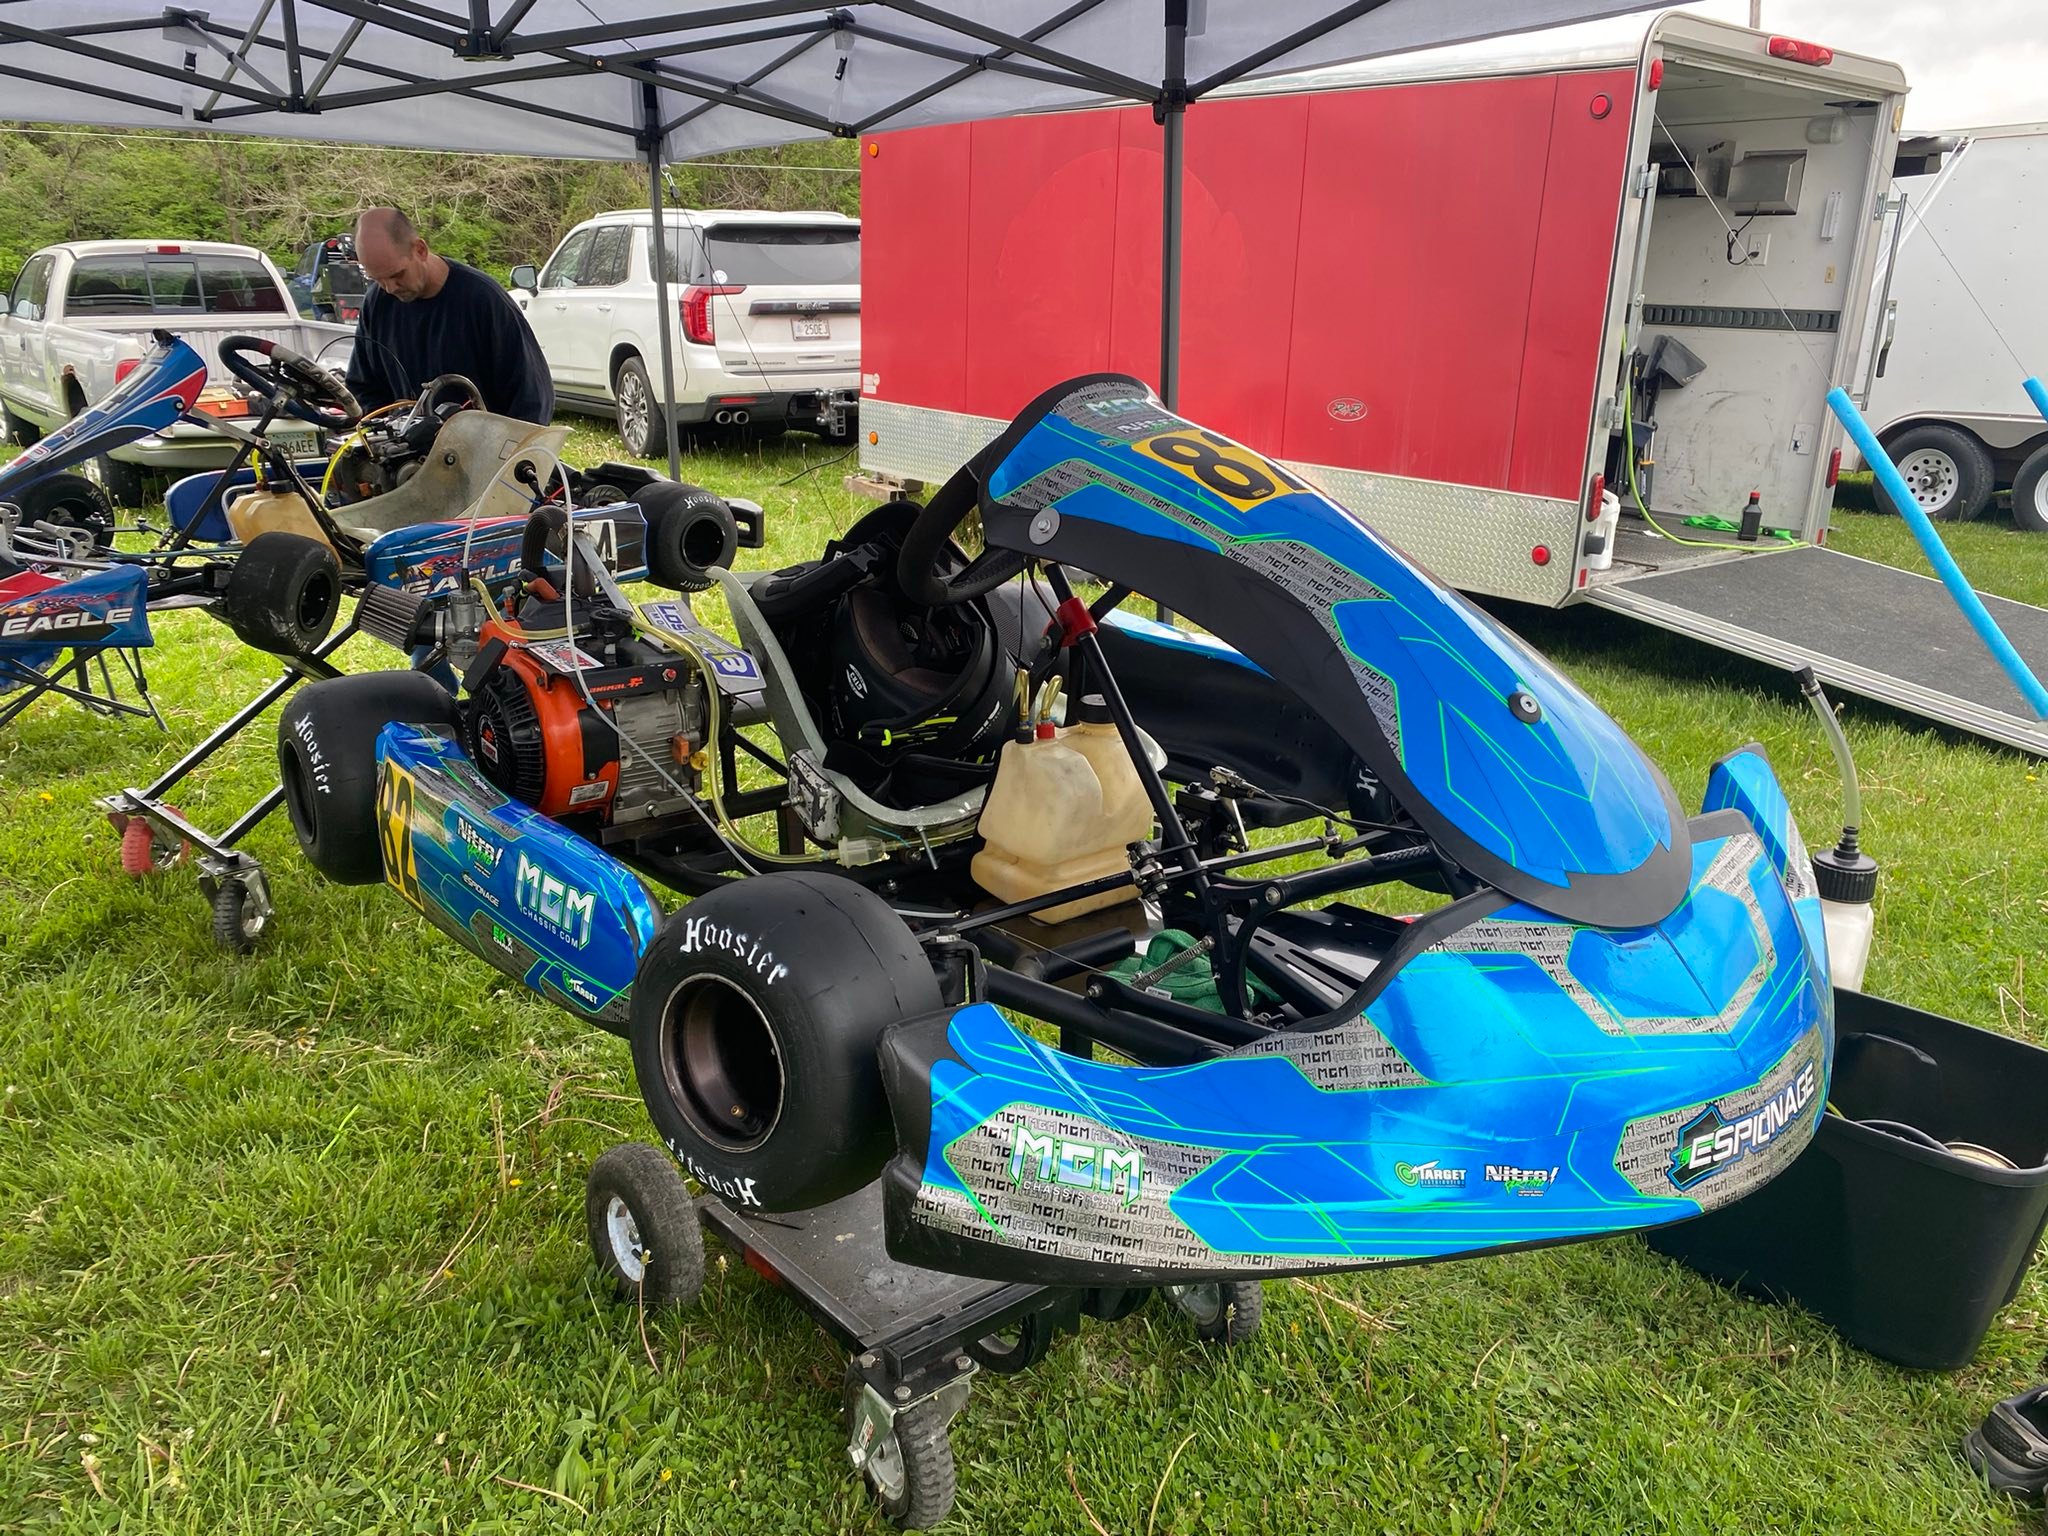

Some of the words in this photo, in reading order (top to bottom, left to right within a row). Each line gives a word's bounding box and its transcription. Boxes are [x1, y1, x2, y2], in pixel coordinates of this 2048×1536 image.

[2, 608, 133, 636] EAGLE
[294, 712, 331, 794] Hoosier
[379, 762, 423, 906] 82
[462, 873, 500, 907] ESPIONAGE
[516, 850, 597, 952] MGM
[522, 906, 579, 949] CHASSIS.COM
[680, 916, 791, 985] Hoosier
[572, 979, 599, 1005] TARGET
[1688, 1062, 1815, 1169] ESPIONAGE
[666, 1137, 762, 1207] Hoosier
[1009, 1124, 1142, 1206] MGM
[1023, 1180, 1123, 1206] CHASSIS.COM
[1413, 1162, 1467, 1180] TARGET
